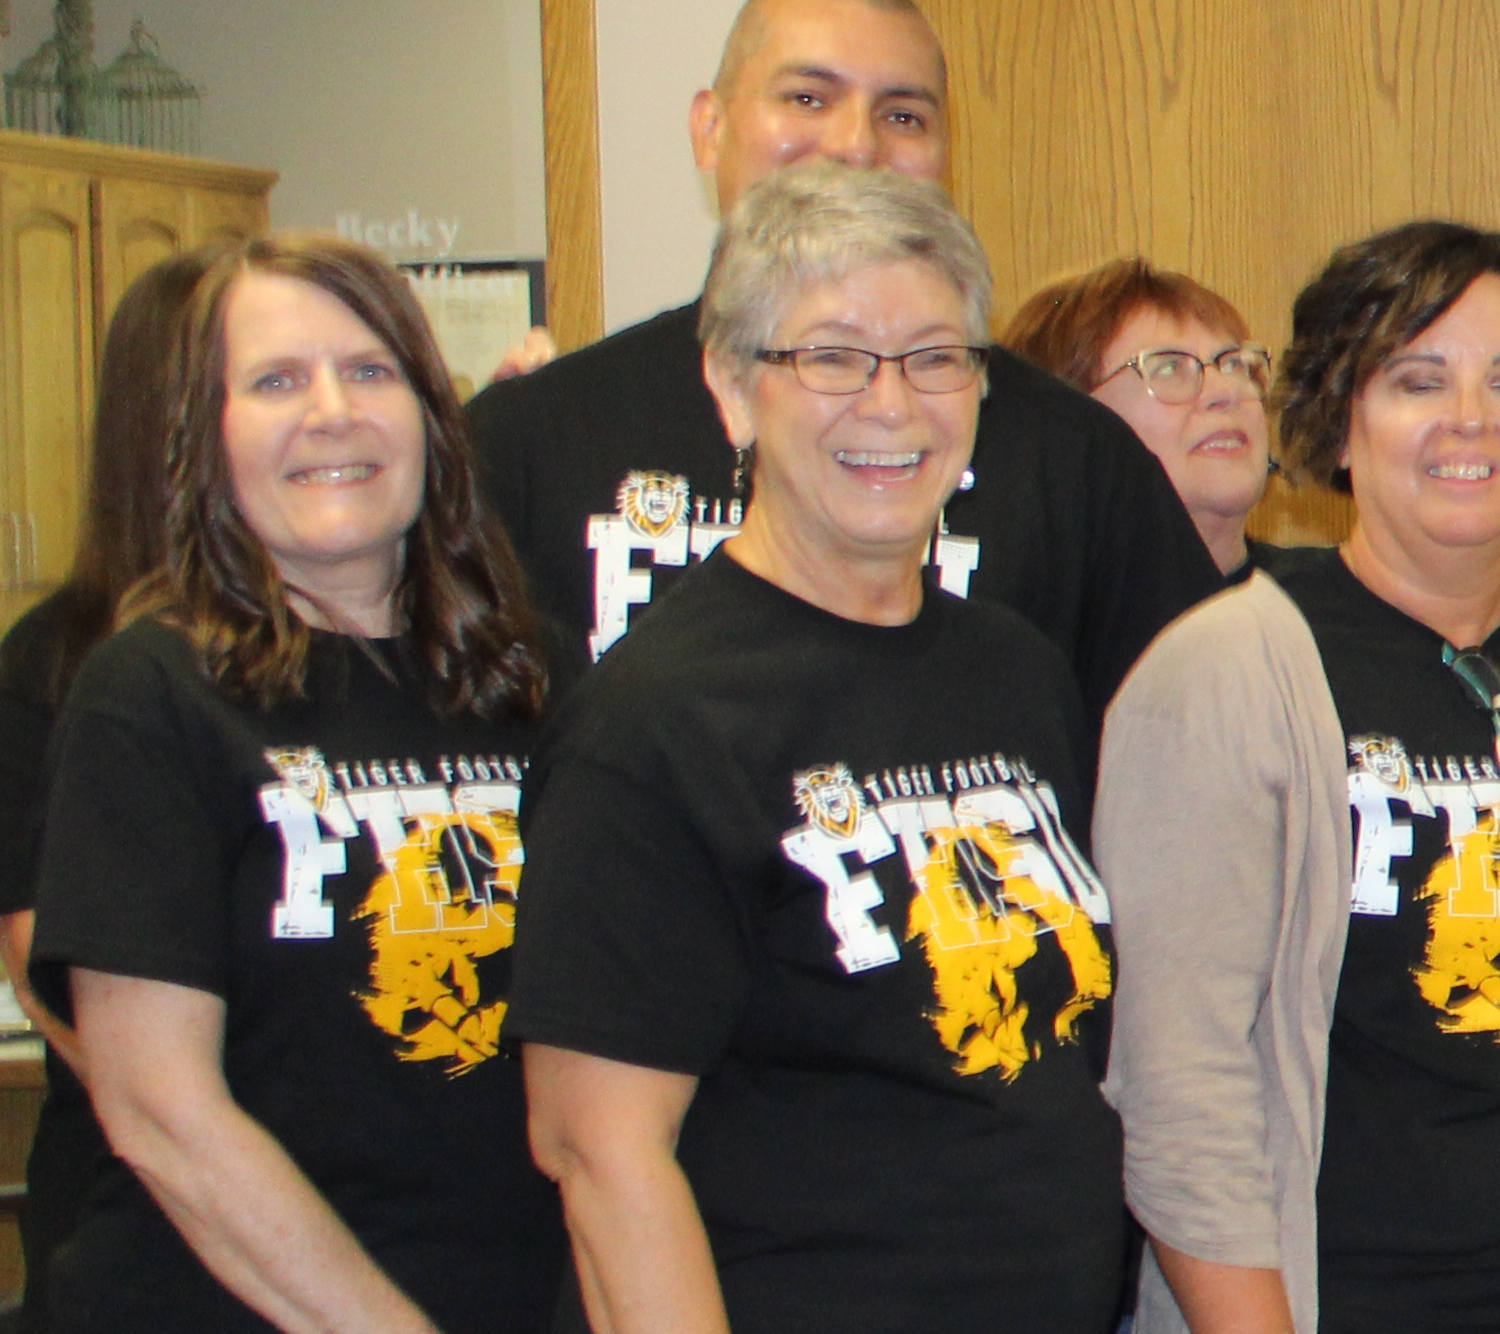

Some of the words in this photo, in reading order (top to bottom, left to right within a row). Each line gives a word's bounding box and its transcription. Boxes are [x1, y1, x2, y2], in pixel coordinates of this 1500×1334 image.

[335, 205, 462, 257] Becky
[336, 755, 427, 791] TIGER
[437, 753, 530, 784] FOOTB
[863, 762, 935, 802] TIGER
[1413, 752, 1498, 782] TIGER
